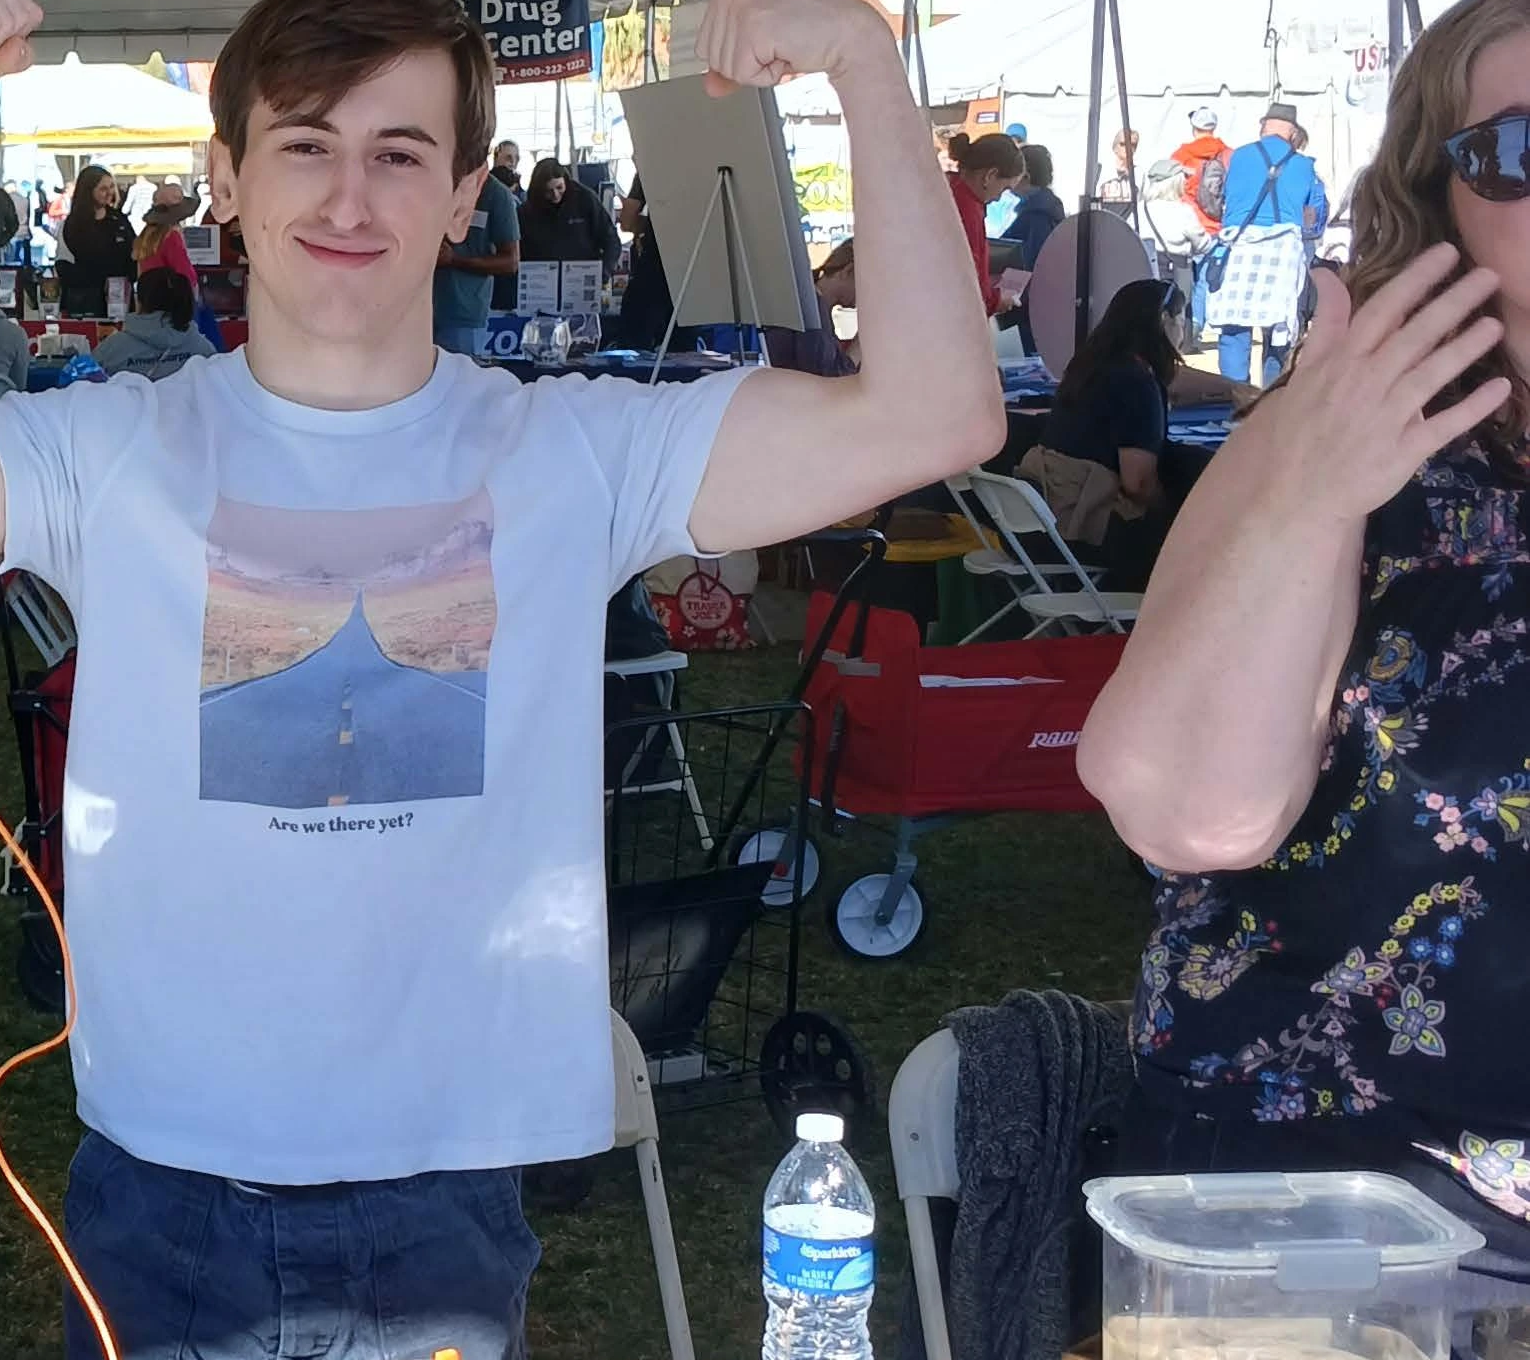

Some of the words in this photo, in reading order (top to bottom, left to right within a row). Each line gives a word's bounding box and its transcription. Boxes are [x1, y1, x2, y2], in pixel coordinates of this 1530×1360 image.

[510, 58, 585, 78] 1-800-222-1222
[269, 816, 299, 833] Are
[302, 820, 326, 834] we
[328, 817, 376, 832] there
[378, 812, 414, 834] yet?
